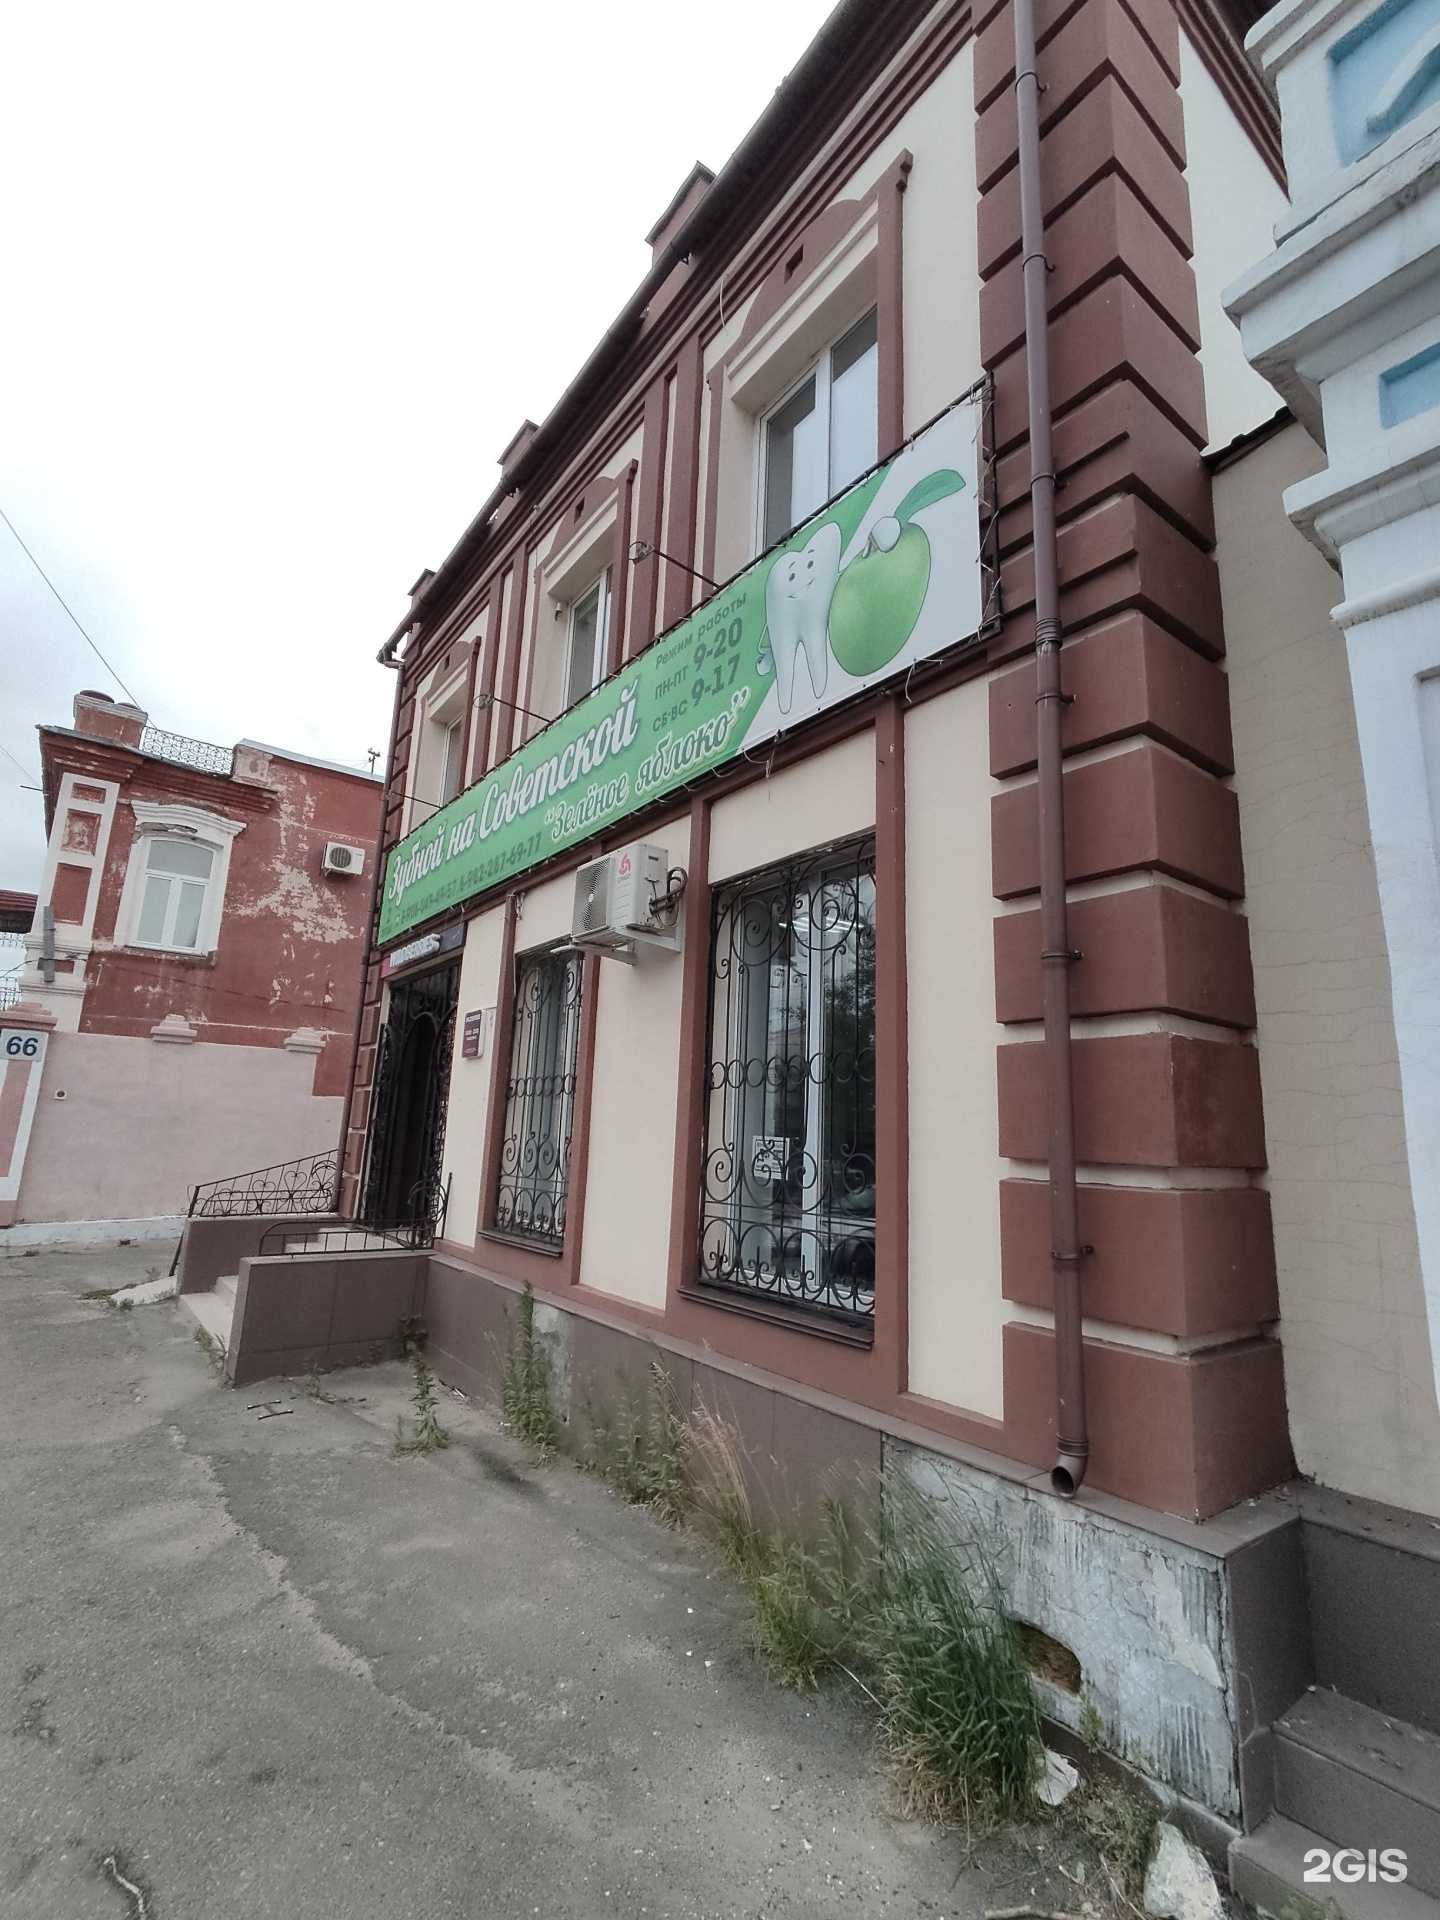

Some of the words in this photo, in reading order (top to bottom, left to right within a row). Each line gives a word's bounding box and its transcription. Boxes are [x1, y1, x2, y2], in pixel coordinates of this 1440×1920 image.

[655, 633, 693, 670] Режим
[697, 592, 747, 641] работы
[692, 617, 743, 672] 9-20
[691, 653, 740, 706] 9-17
[388, 825, 446, 906] Зубной
[446, 814, 476, 861] на
[479, 677, 640, 839] Советской
[6, 1036, 39, 1057] 66
